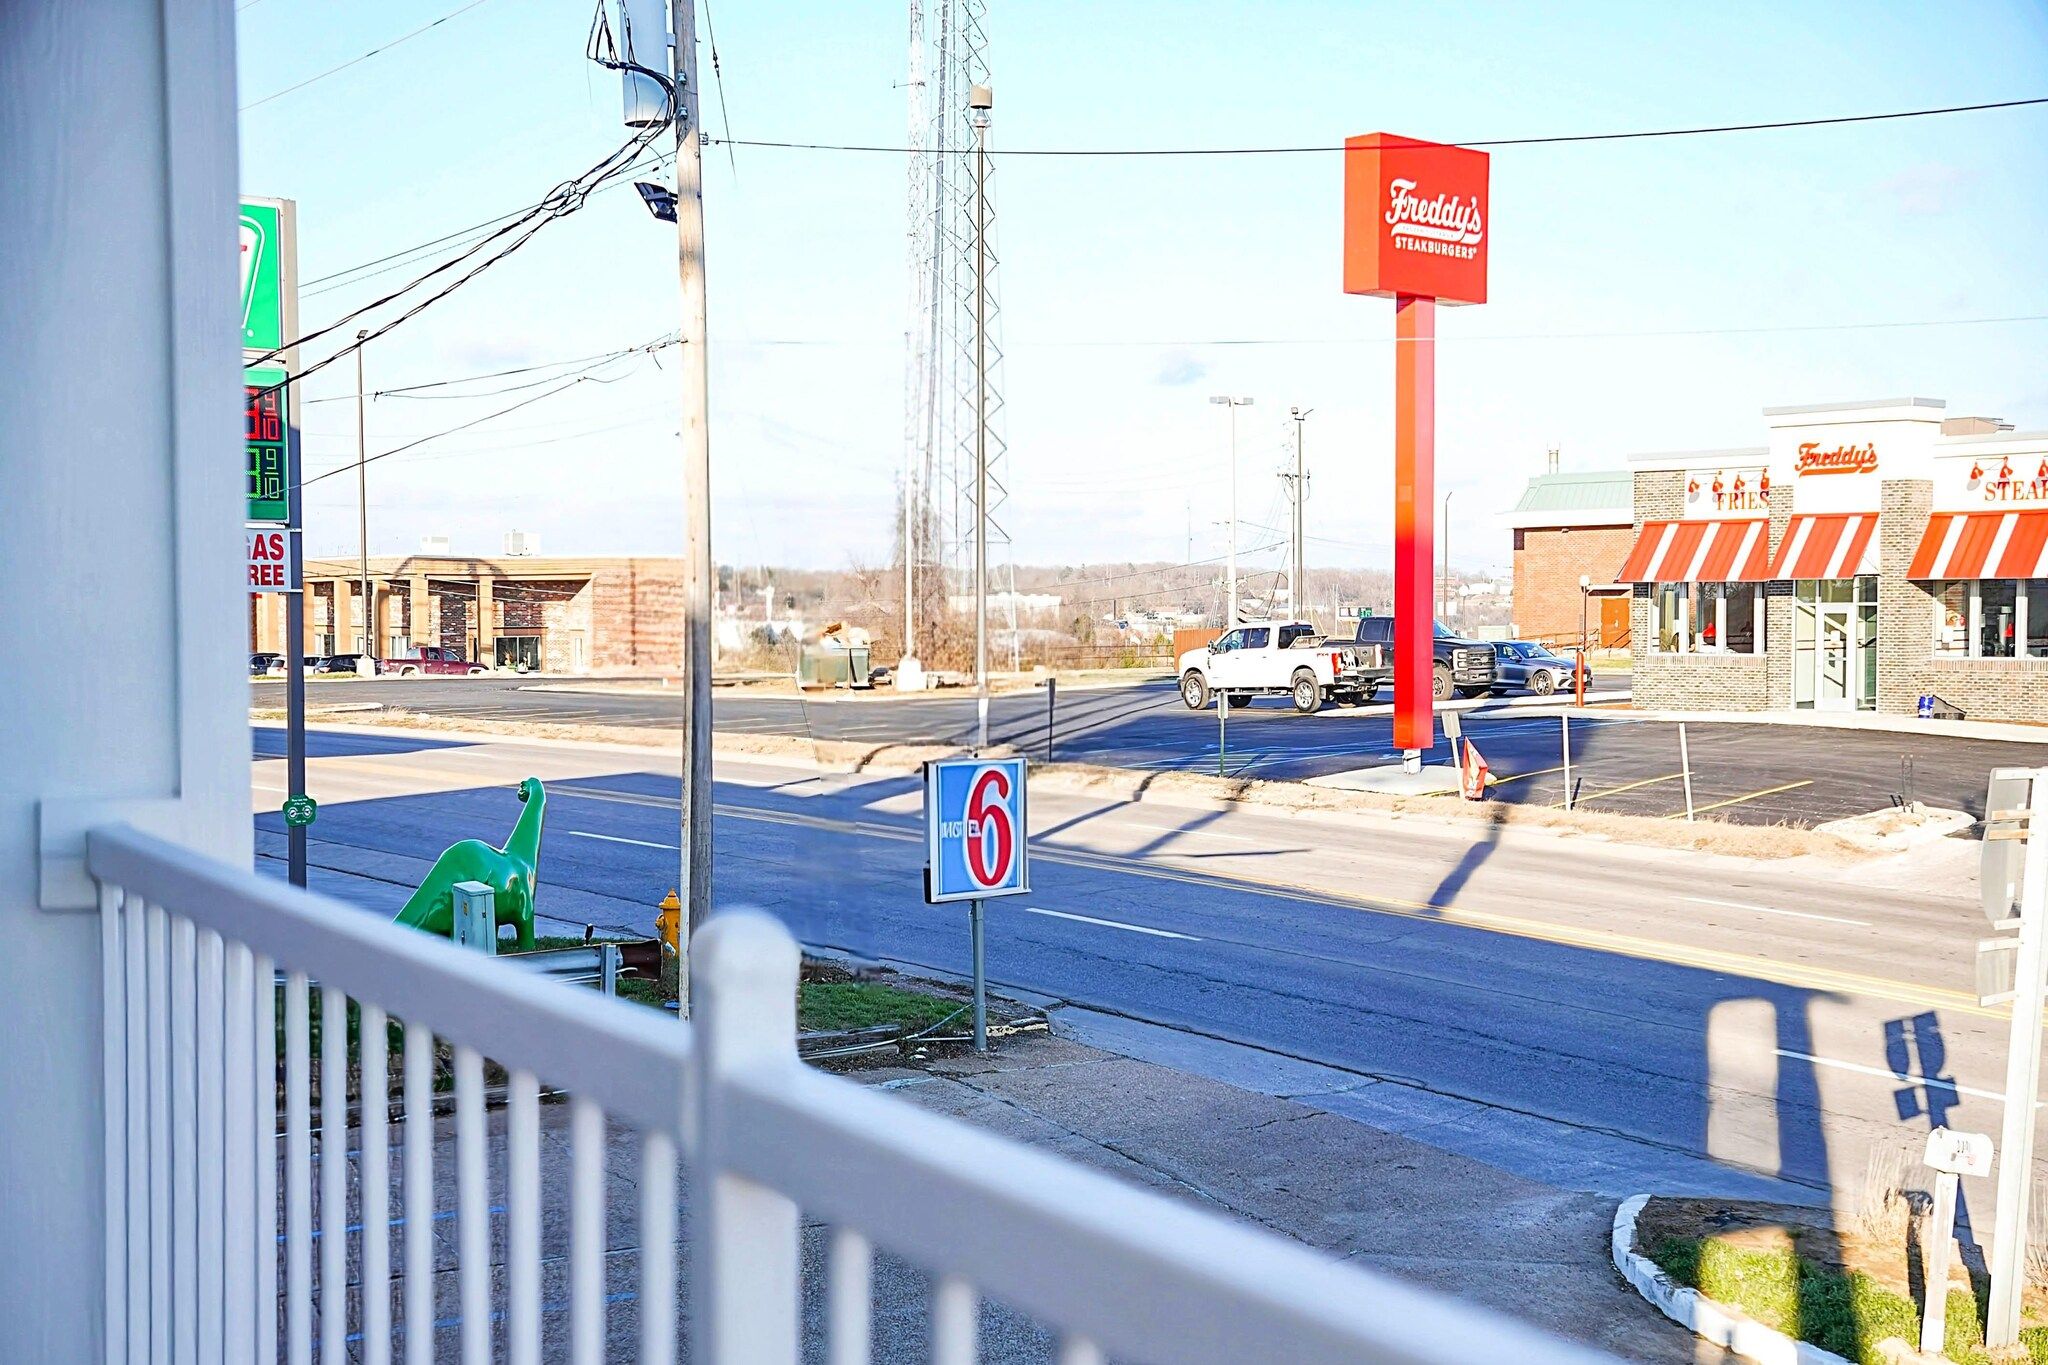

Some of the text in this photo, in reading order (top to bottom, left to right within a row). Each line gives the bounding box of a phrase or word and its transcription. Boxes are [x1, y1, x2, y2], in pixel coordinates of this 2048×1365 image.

[1385, 178, 1482, 234] Freddy's
[1395, 236, 1474, 259] STEAKBURGERS
[1794, 443, 1877, 473] Freddy's
[1716, 491, 1769, 511] FRIES
[247, 533, 284, 560] AS
[967, 770, 1012, 886] 6
